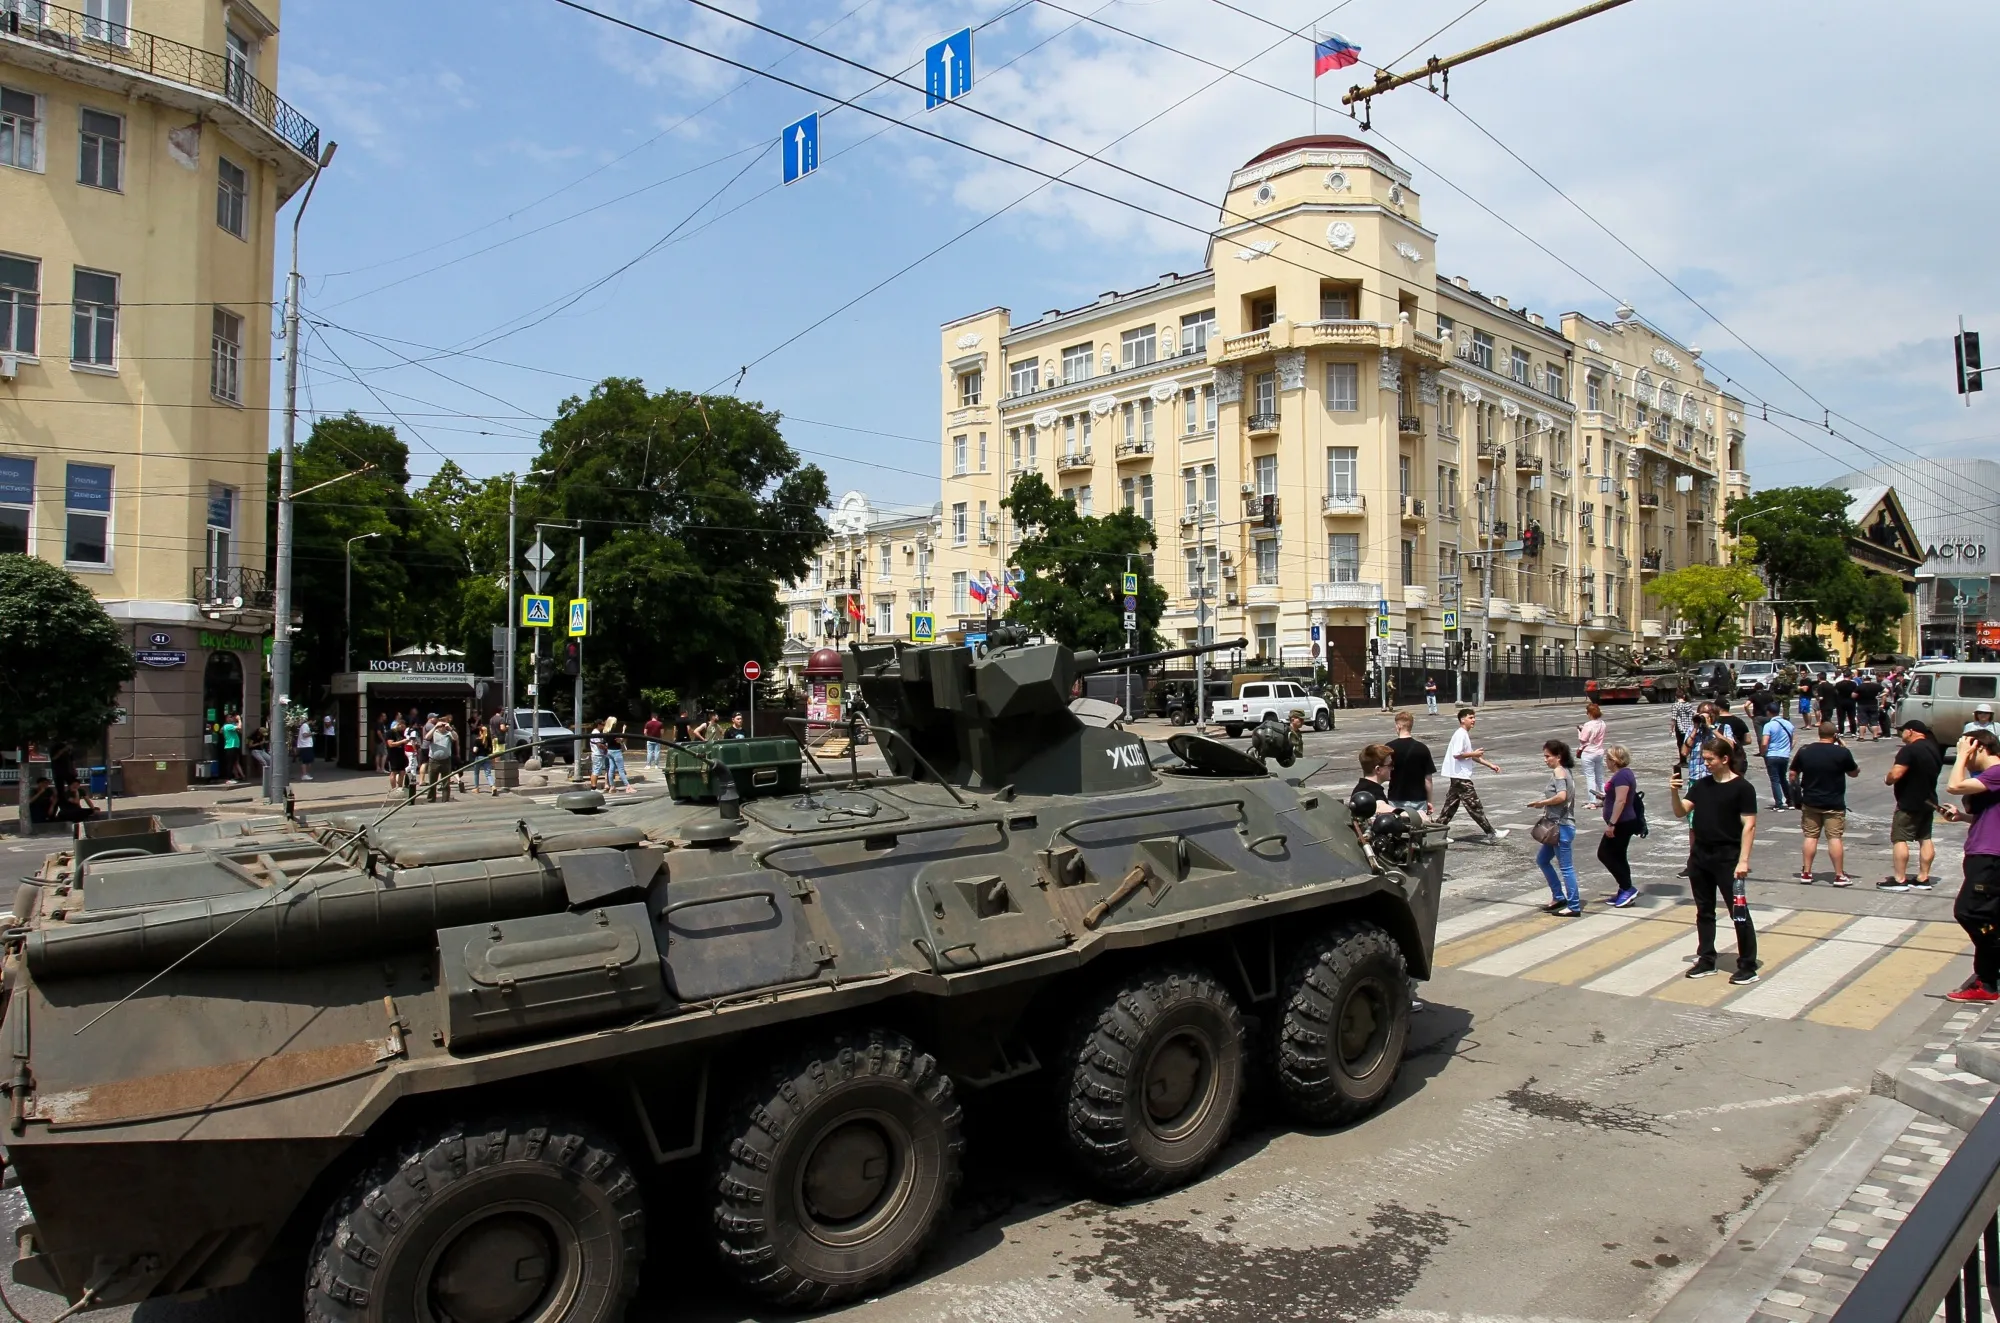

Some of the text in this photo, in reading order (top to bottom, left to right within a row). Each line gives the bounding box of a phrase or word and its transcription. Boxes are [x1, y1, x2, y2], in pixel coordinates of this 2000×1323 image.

[1925, 543, 1986, 559] АСТОР
[155, 635, 165, 643] 41
[369, 660, 465, 673] КОФЕ МАФИЯ
